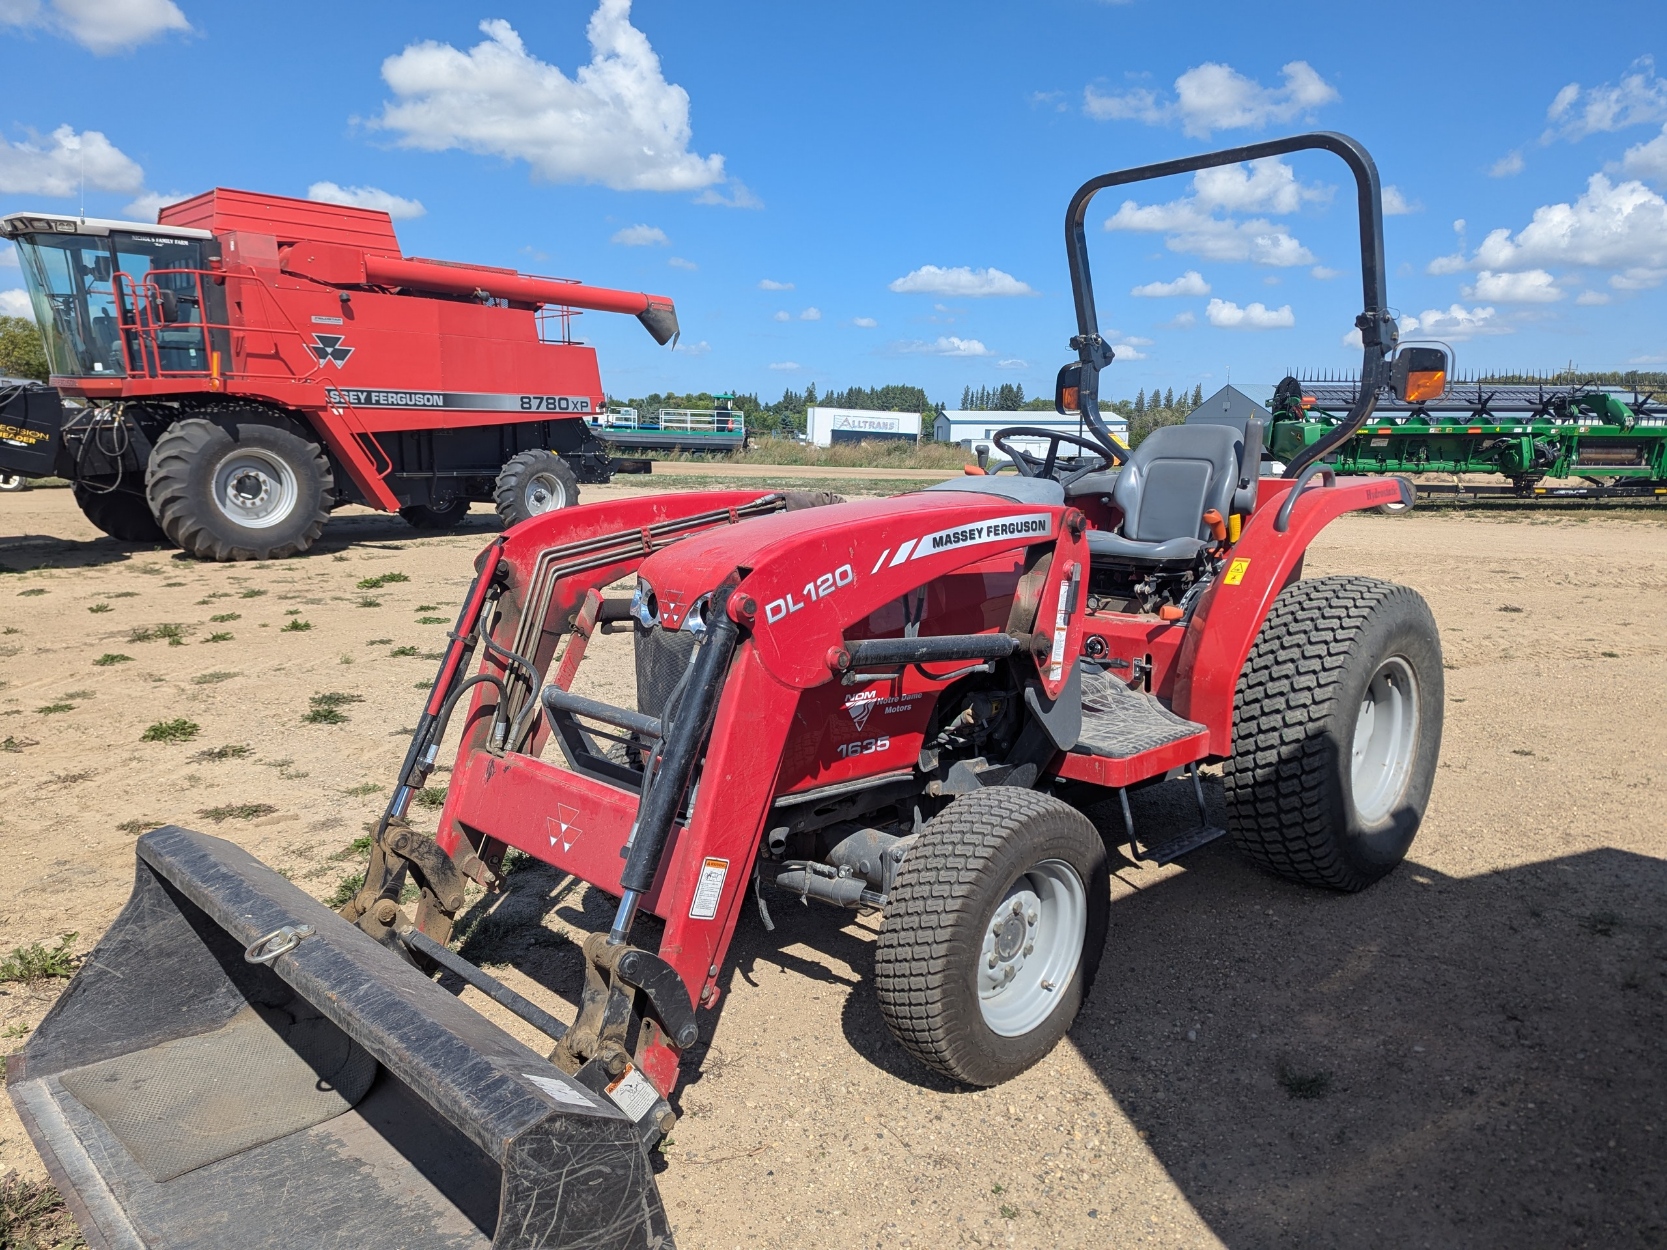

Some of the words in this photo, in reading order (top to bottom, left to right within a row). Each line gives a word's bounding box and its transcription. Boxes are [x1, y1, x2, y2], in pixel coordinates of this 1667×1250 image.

[371, 392, 444, 406] FERGUSON
[838, 416, 896, 431] ALLTRANS
[932, 526, 984, 549] MASSEY
[986, 519, 1047, 538] FERGUSON
[876, 695, 900, 706] Notre
[901, 692, 923, 702] Dame
[884, 704, 912, 715] Motors
[837, 735, 890, 758] 1635
